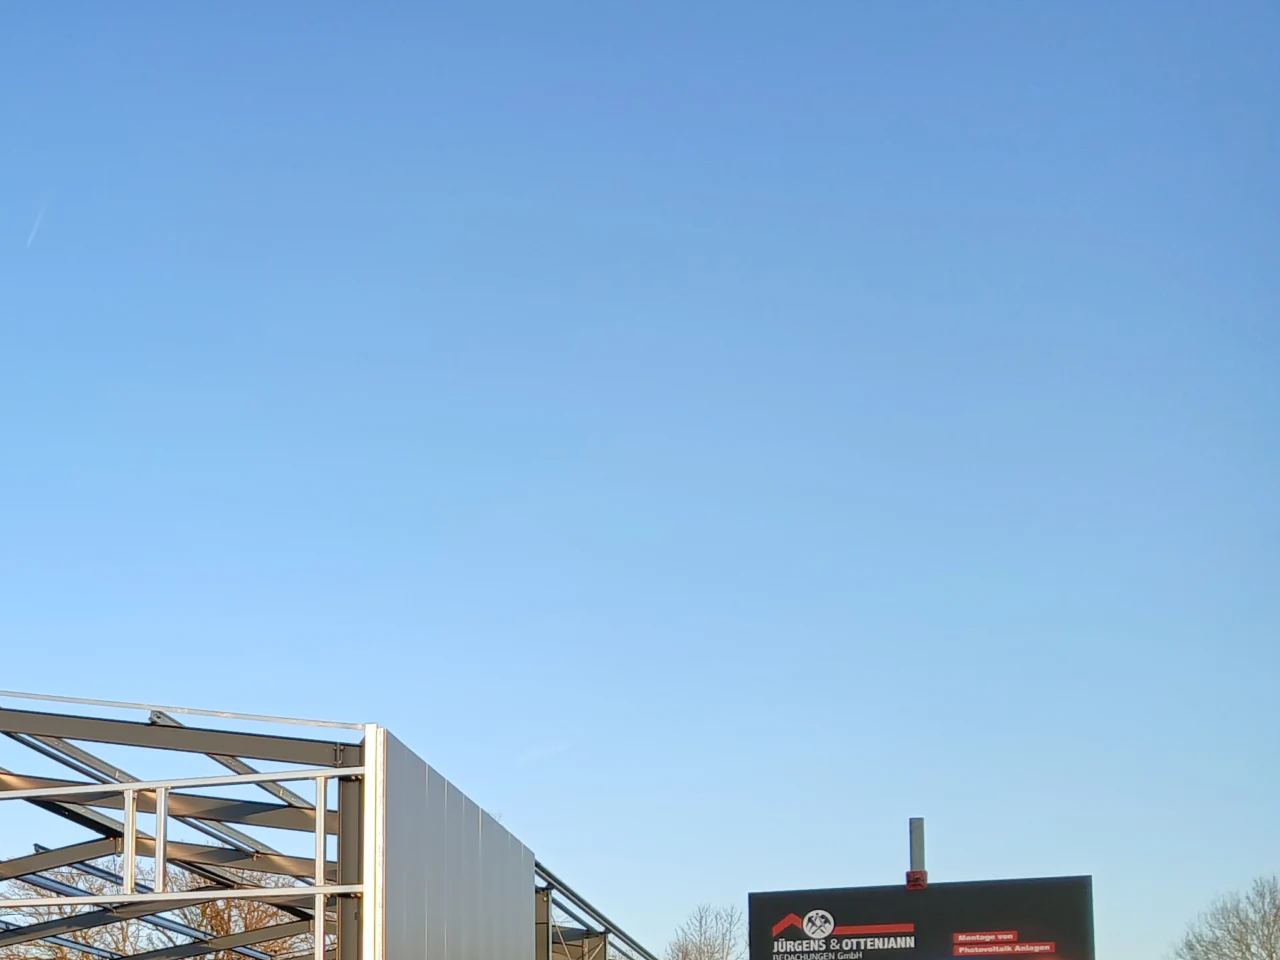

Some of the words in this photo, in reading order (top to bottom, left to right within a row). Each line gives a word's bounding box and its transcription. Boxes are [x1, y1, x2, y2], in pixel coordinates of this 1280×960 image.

[958, 934, 995, 942] Montage
[772, 938, 826, 952] JÜRGENS
[830, 939, 840, 950] &
[842, 936, 915, 950] OTTENJANN
[1014, 944, 1050, 952] Anlagen
[837, 951, 863, 960] GmbH
